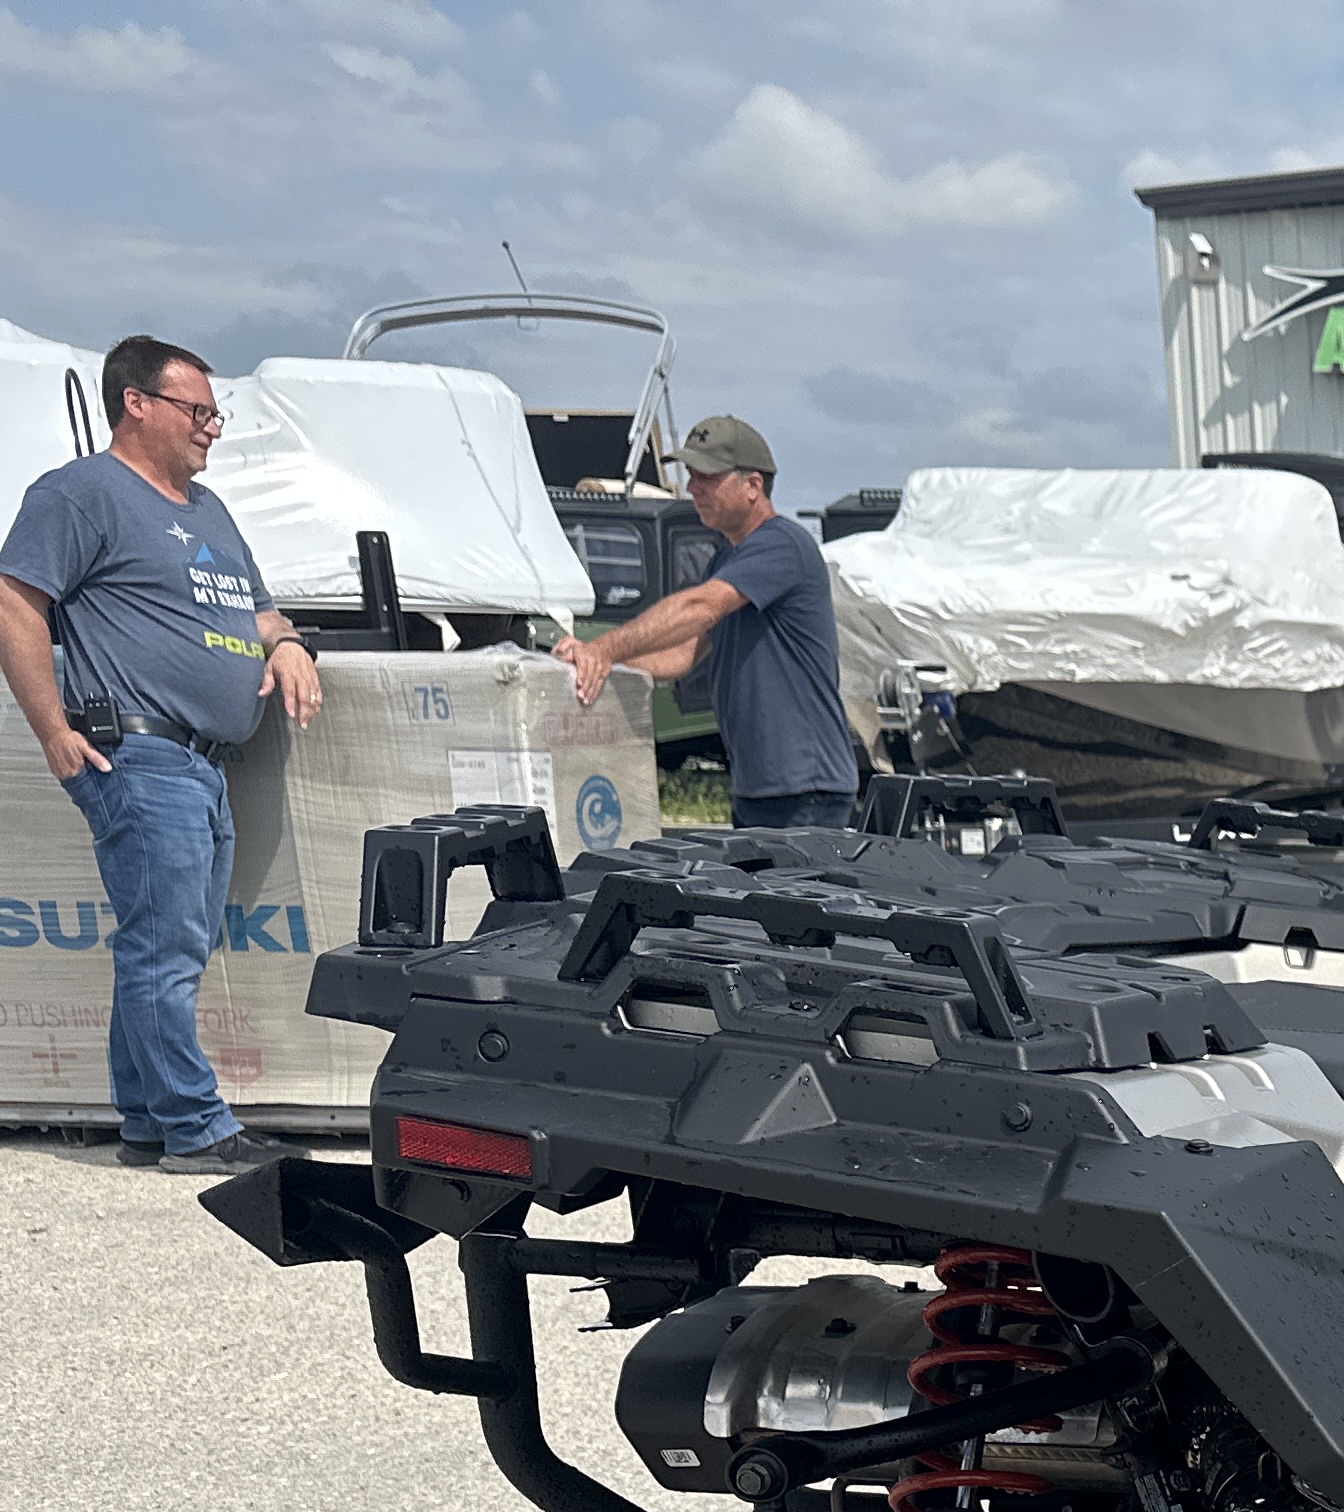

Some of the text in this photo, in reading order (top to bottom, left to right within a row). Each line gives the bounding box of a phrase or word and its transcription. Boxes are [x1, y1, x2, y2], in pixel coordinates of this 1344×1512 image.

[203, 630, 266, 662] POLA
[0, 895, 311, 953] SUKI
[196, 1006, 258, 1035] ORK
